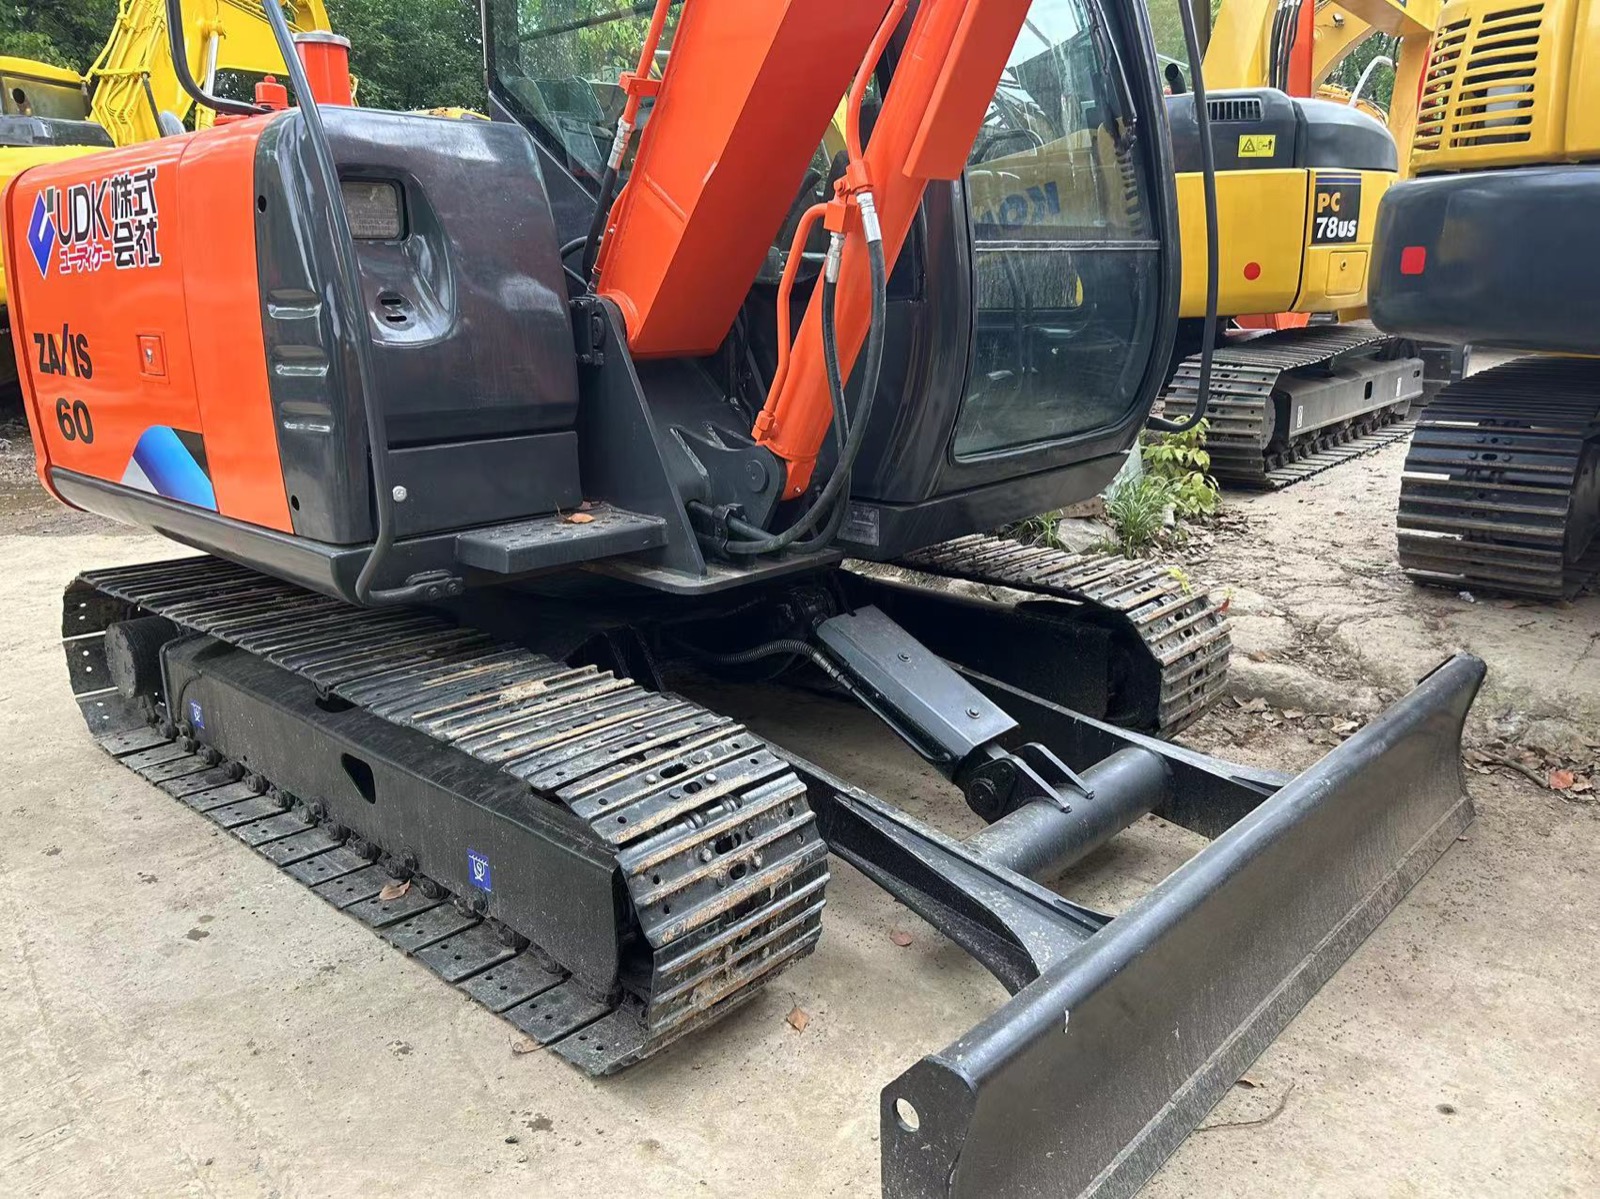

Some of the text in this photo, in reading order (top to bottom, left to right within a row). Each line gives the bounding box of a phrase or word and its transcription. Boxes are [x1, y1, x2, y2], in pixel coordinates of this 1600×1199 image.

[56, 180, 110, 246] UDK
[111, 168, 157, 220] 株式
[1317, 192, 1341, 213] PC
[113, 217, 160, 267] 会社
[56, 397, 94, 445] 60
